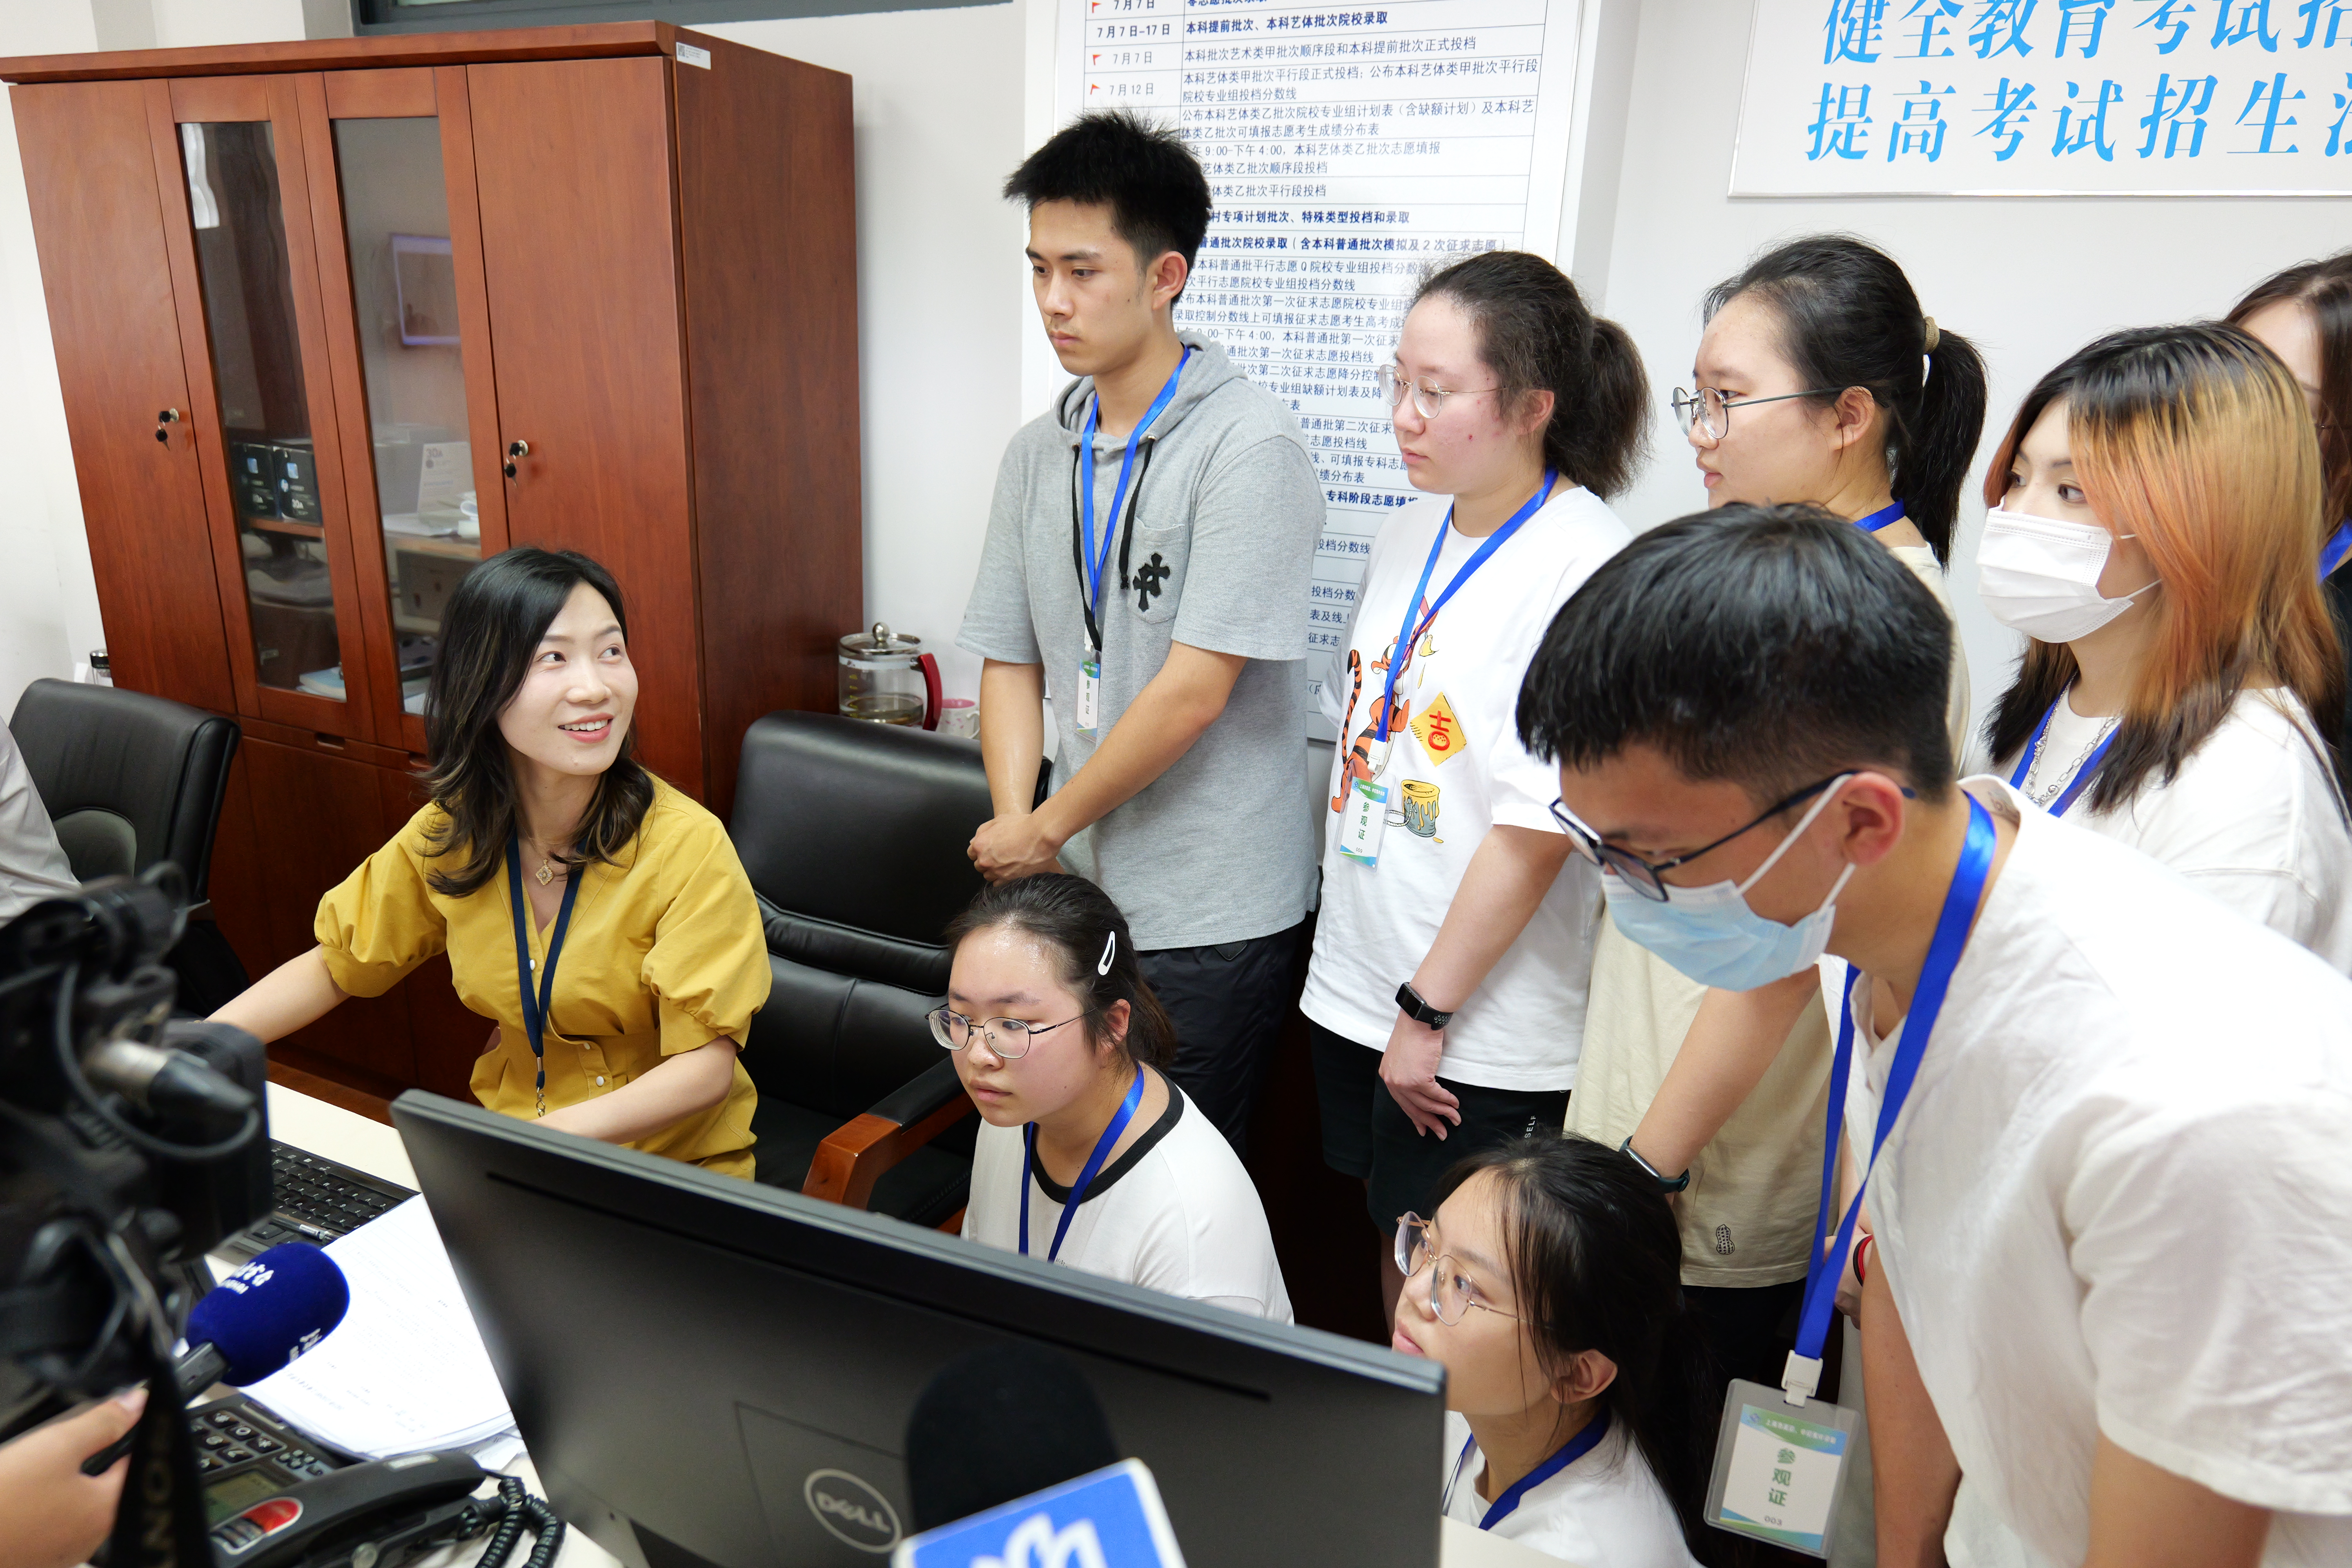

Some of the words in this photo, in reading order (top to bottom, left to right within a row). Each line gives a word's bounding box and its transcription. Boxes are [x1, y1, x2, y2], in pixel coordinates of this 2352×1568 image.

[1186, 11, 1388, 34] 本科提前批次、本科艺体批次院校录取
[1183, 87, 1297, 103] 院校专业组投档分数线
[1357, 801, 1370, 840] 参观证
[1769, 1448, 1796, 1506] 参观证
[815, 1491, 892, 1535] DELL
